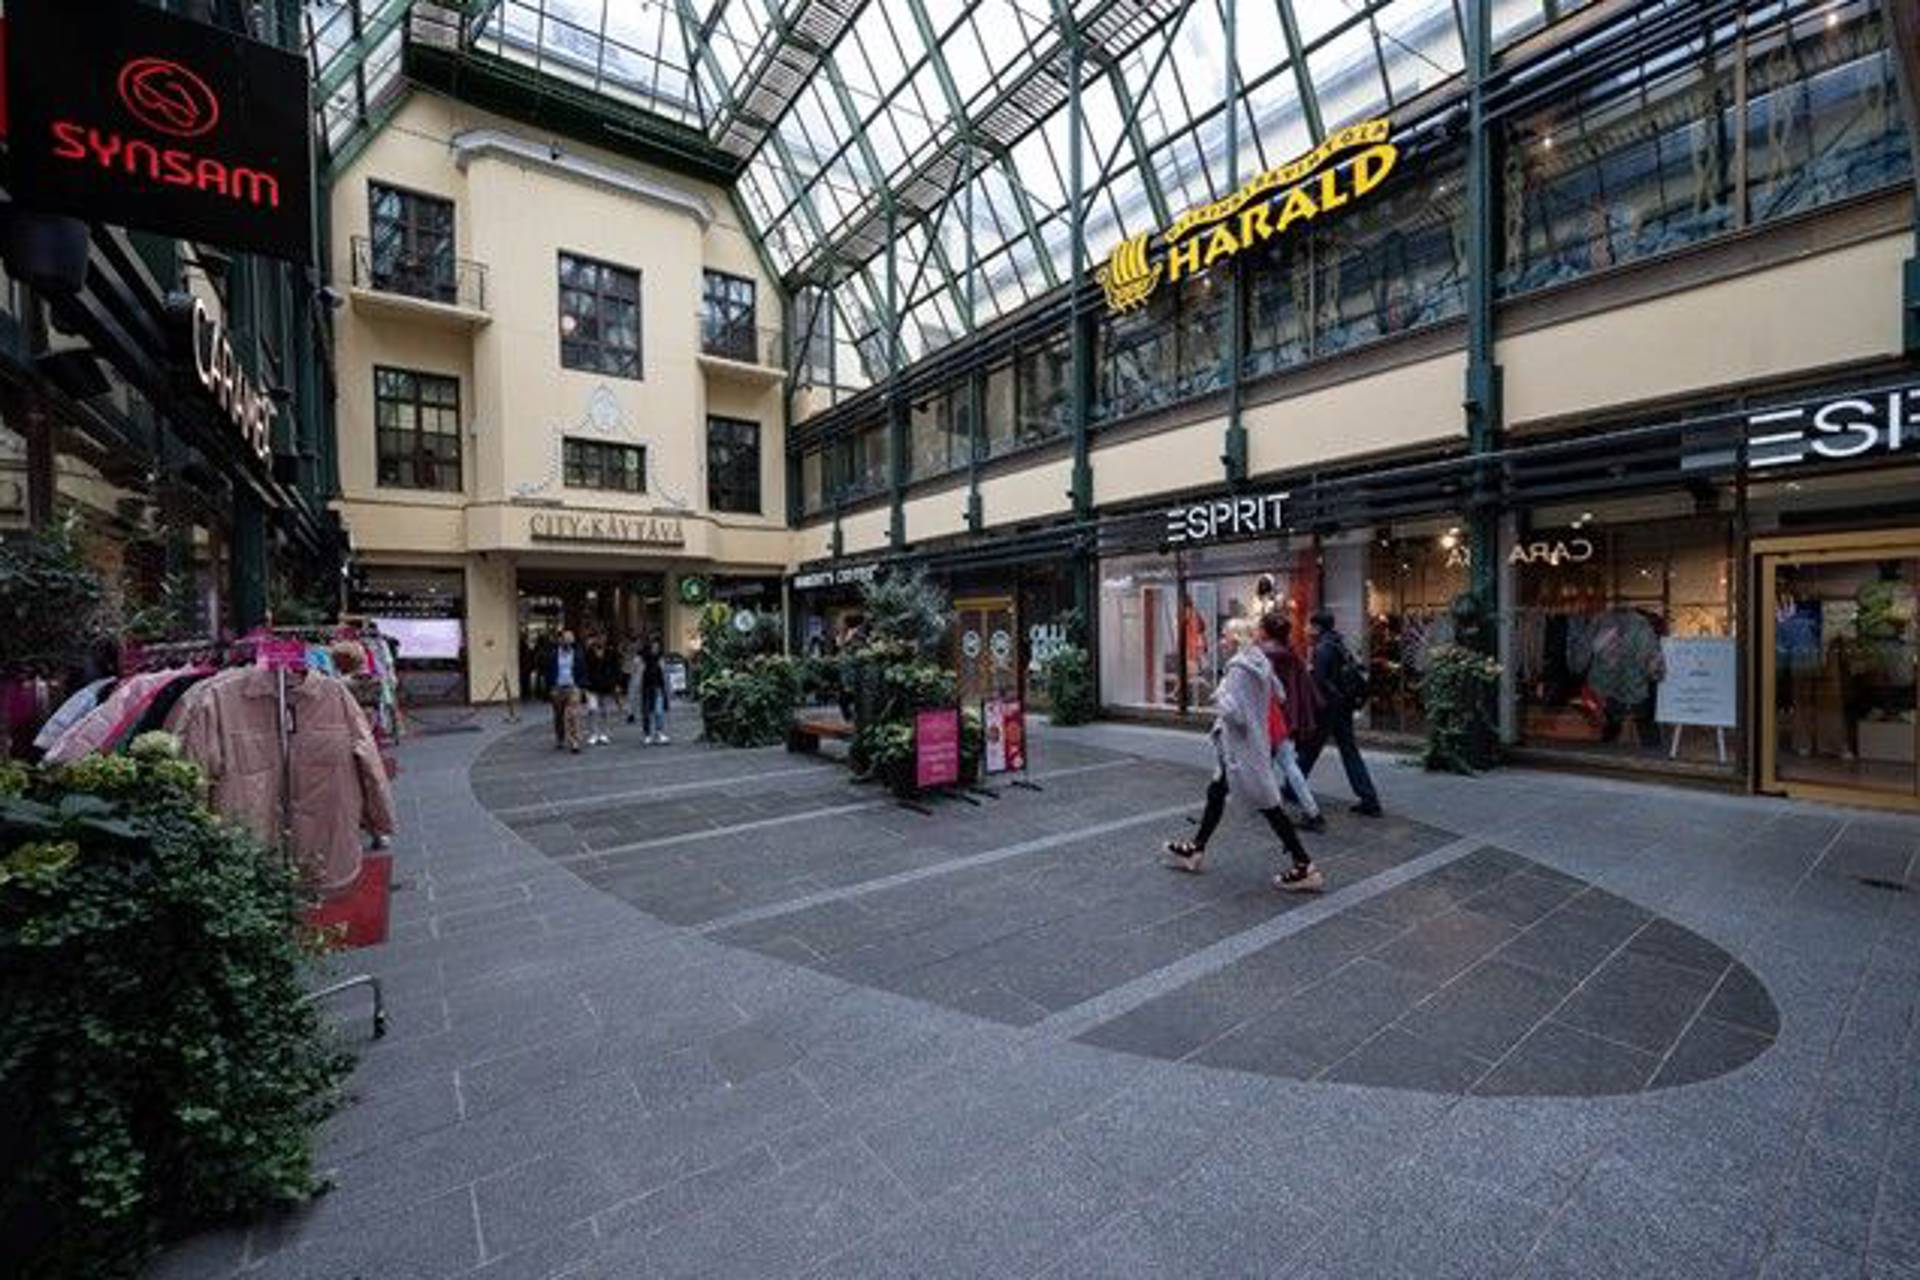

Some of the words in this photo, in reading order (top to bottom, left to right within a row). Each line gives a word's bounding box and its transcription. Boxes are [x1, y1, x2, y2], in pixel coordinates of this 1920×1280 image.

[53, 121, 279, 207] SYNSAM
[1168, 143, 1398, 283] HARALD
[1167, 492, 1290, 541] ESPRIT
